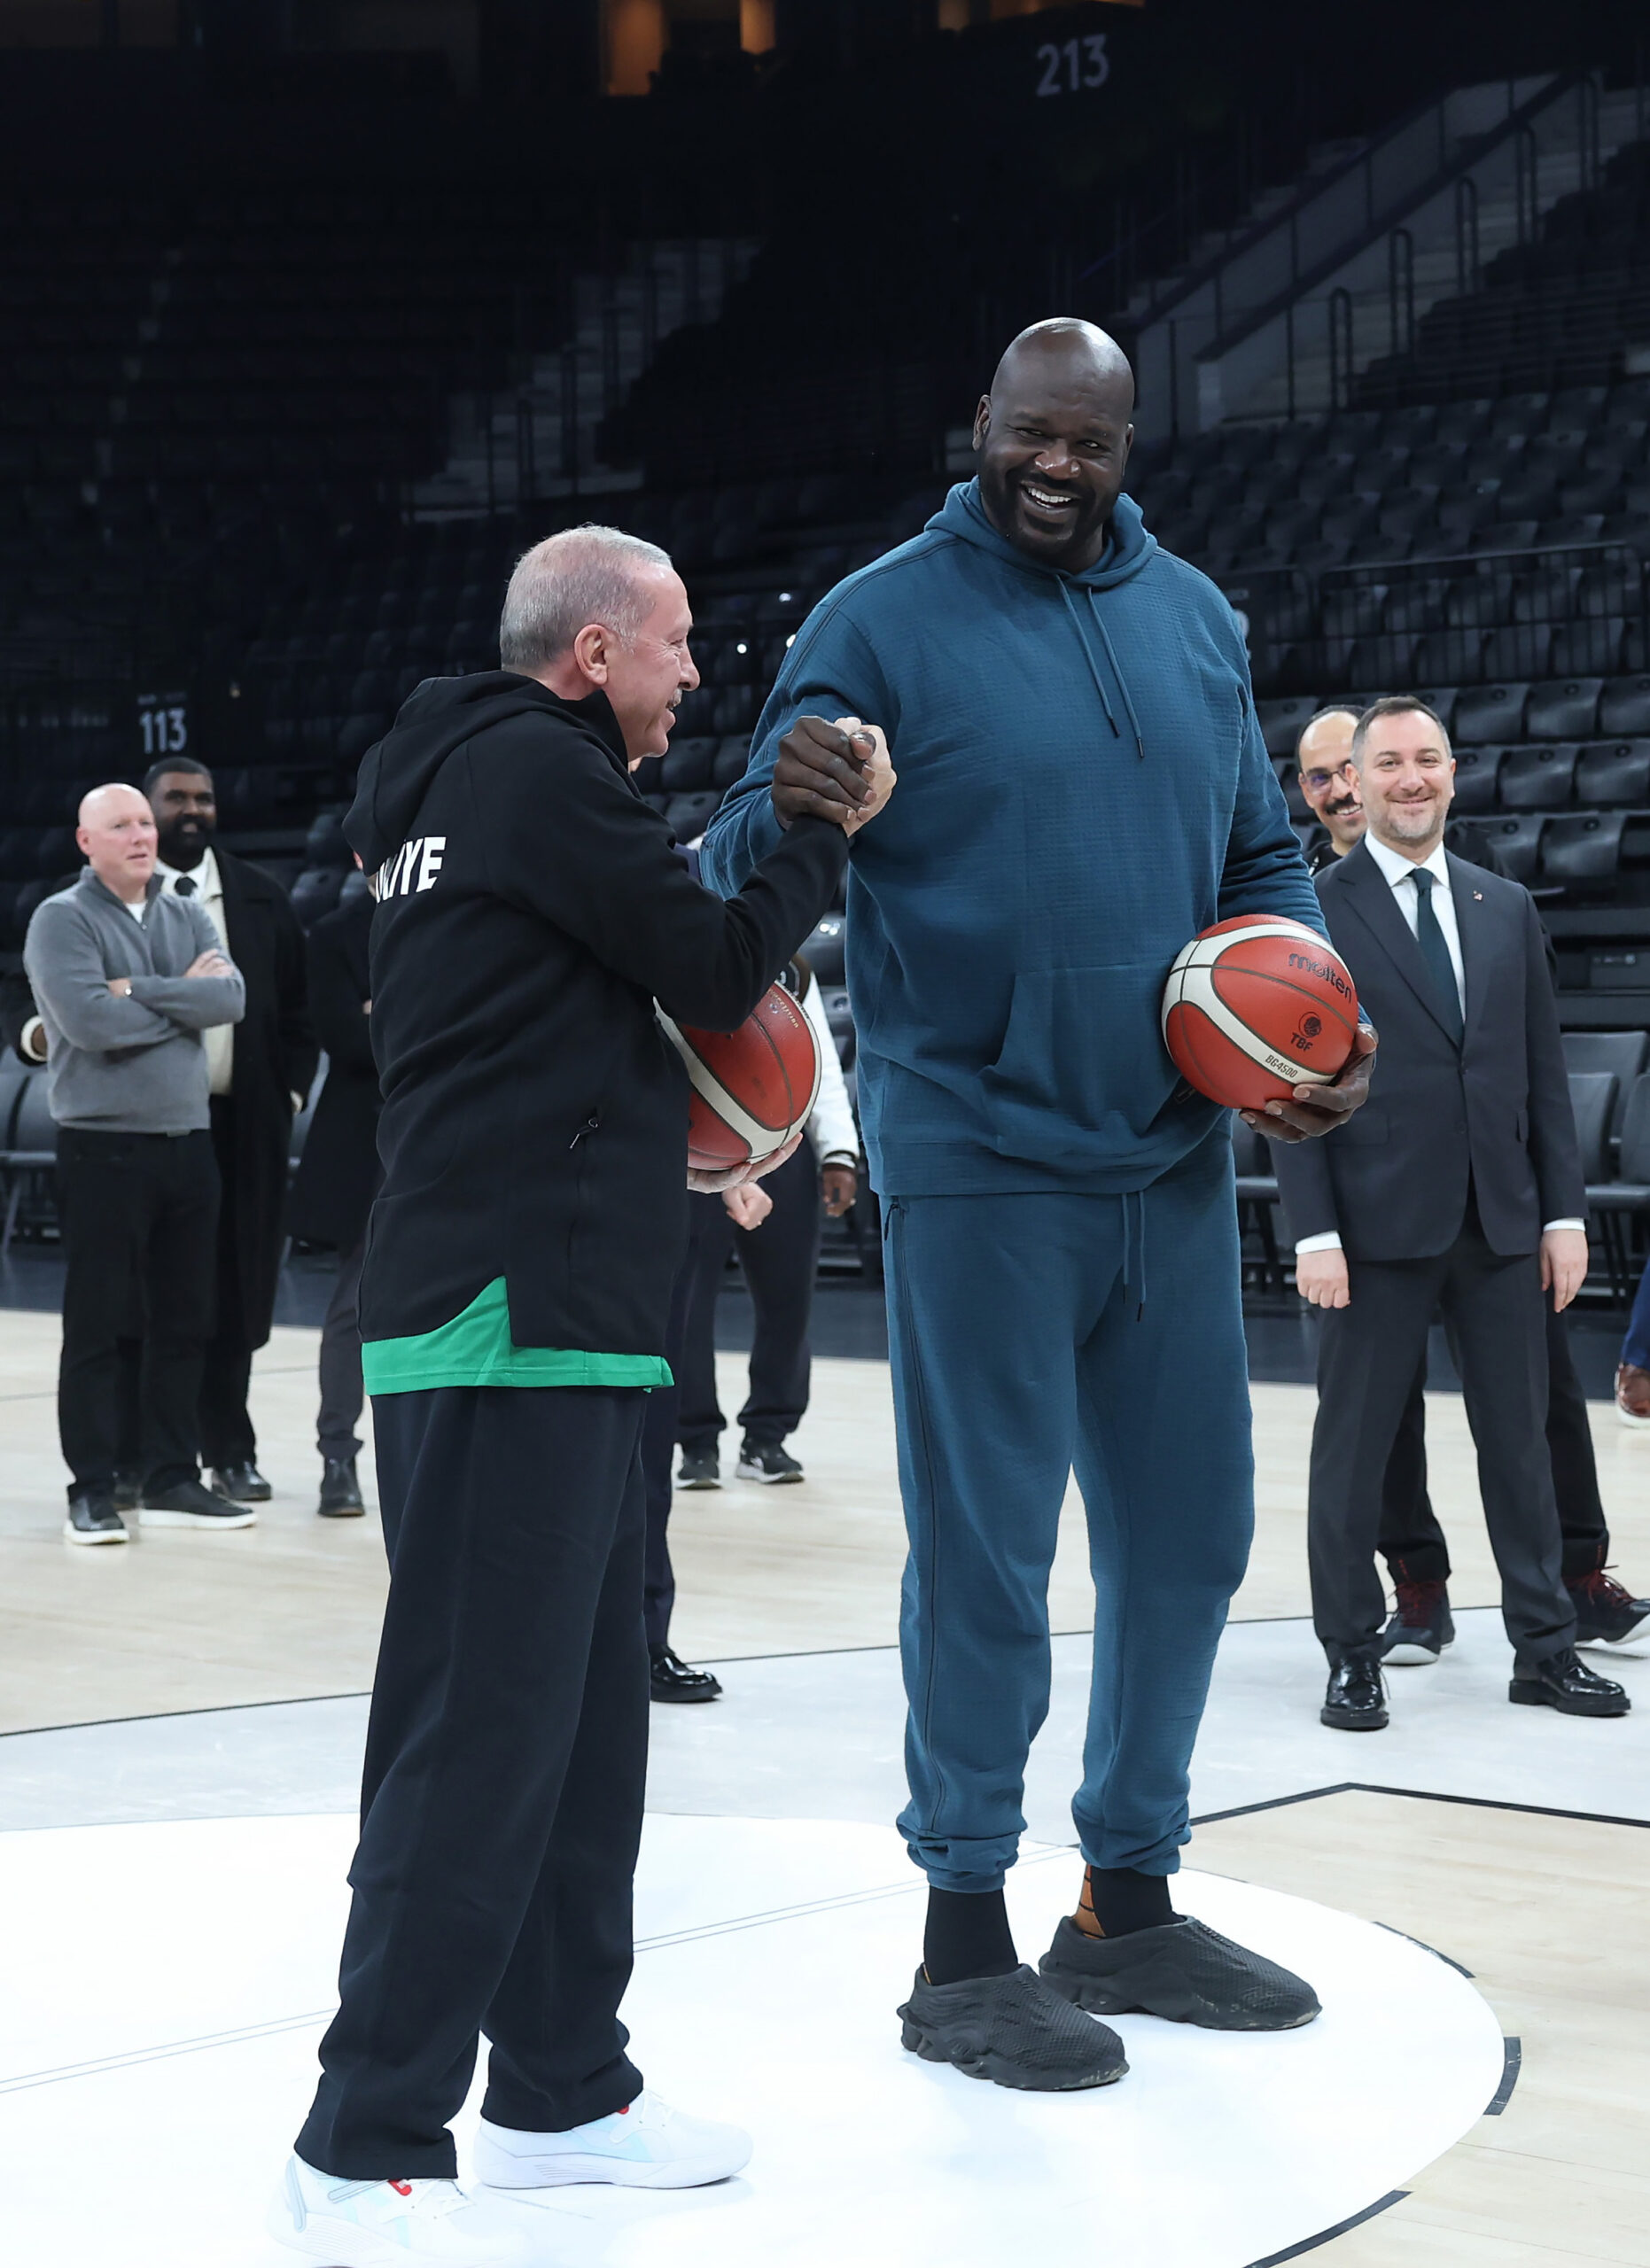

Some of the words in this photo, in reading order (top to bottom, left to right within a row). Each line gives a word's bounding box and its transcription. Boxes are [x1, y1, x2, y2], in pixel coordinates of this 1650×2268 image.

[1035, 33, 1109, 97] 213
[139, 708, 187, 755] 113
[1288, 953, 1352, 1003] molten
[1290, 1032, 1314, 1052] TBF
[1265, 1054, 1298, 1078] BG4500
